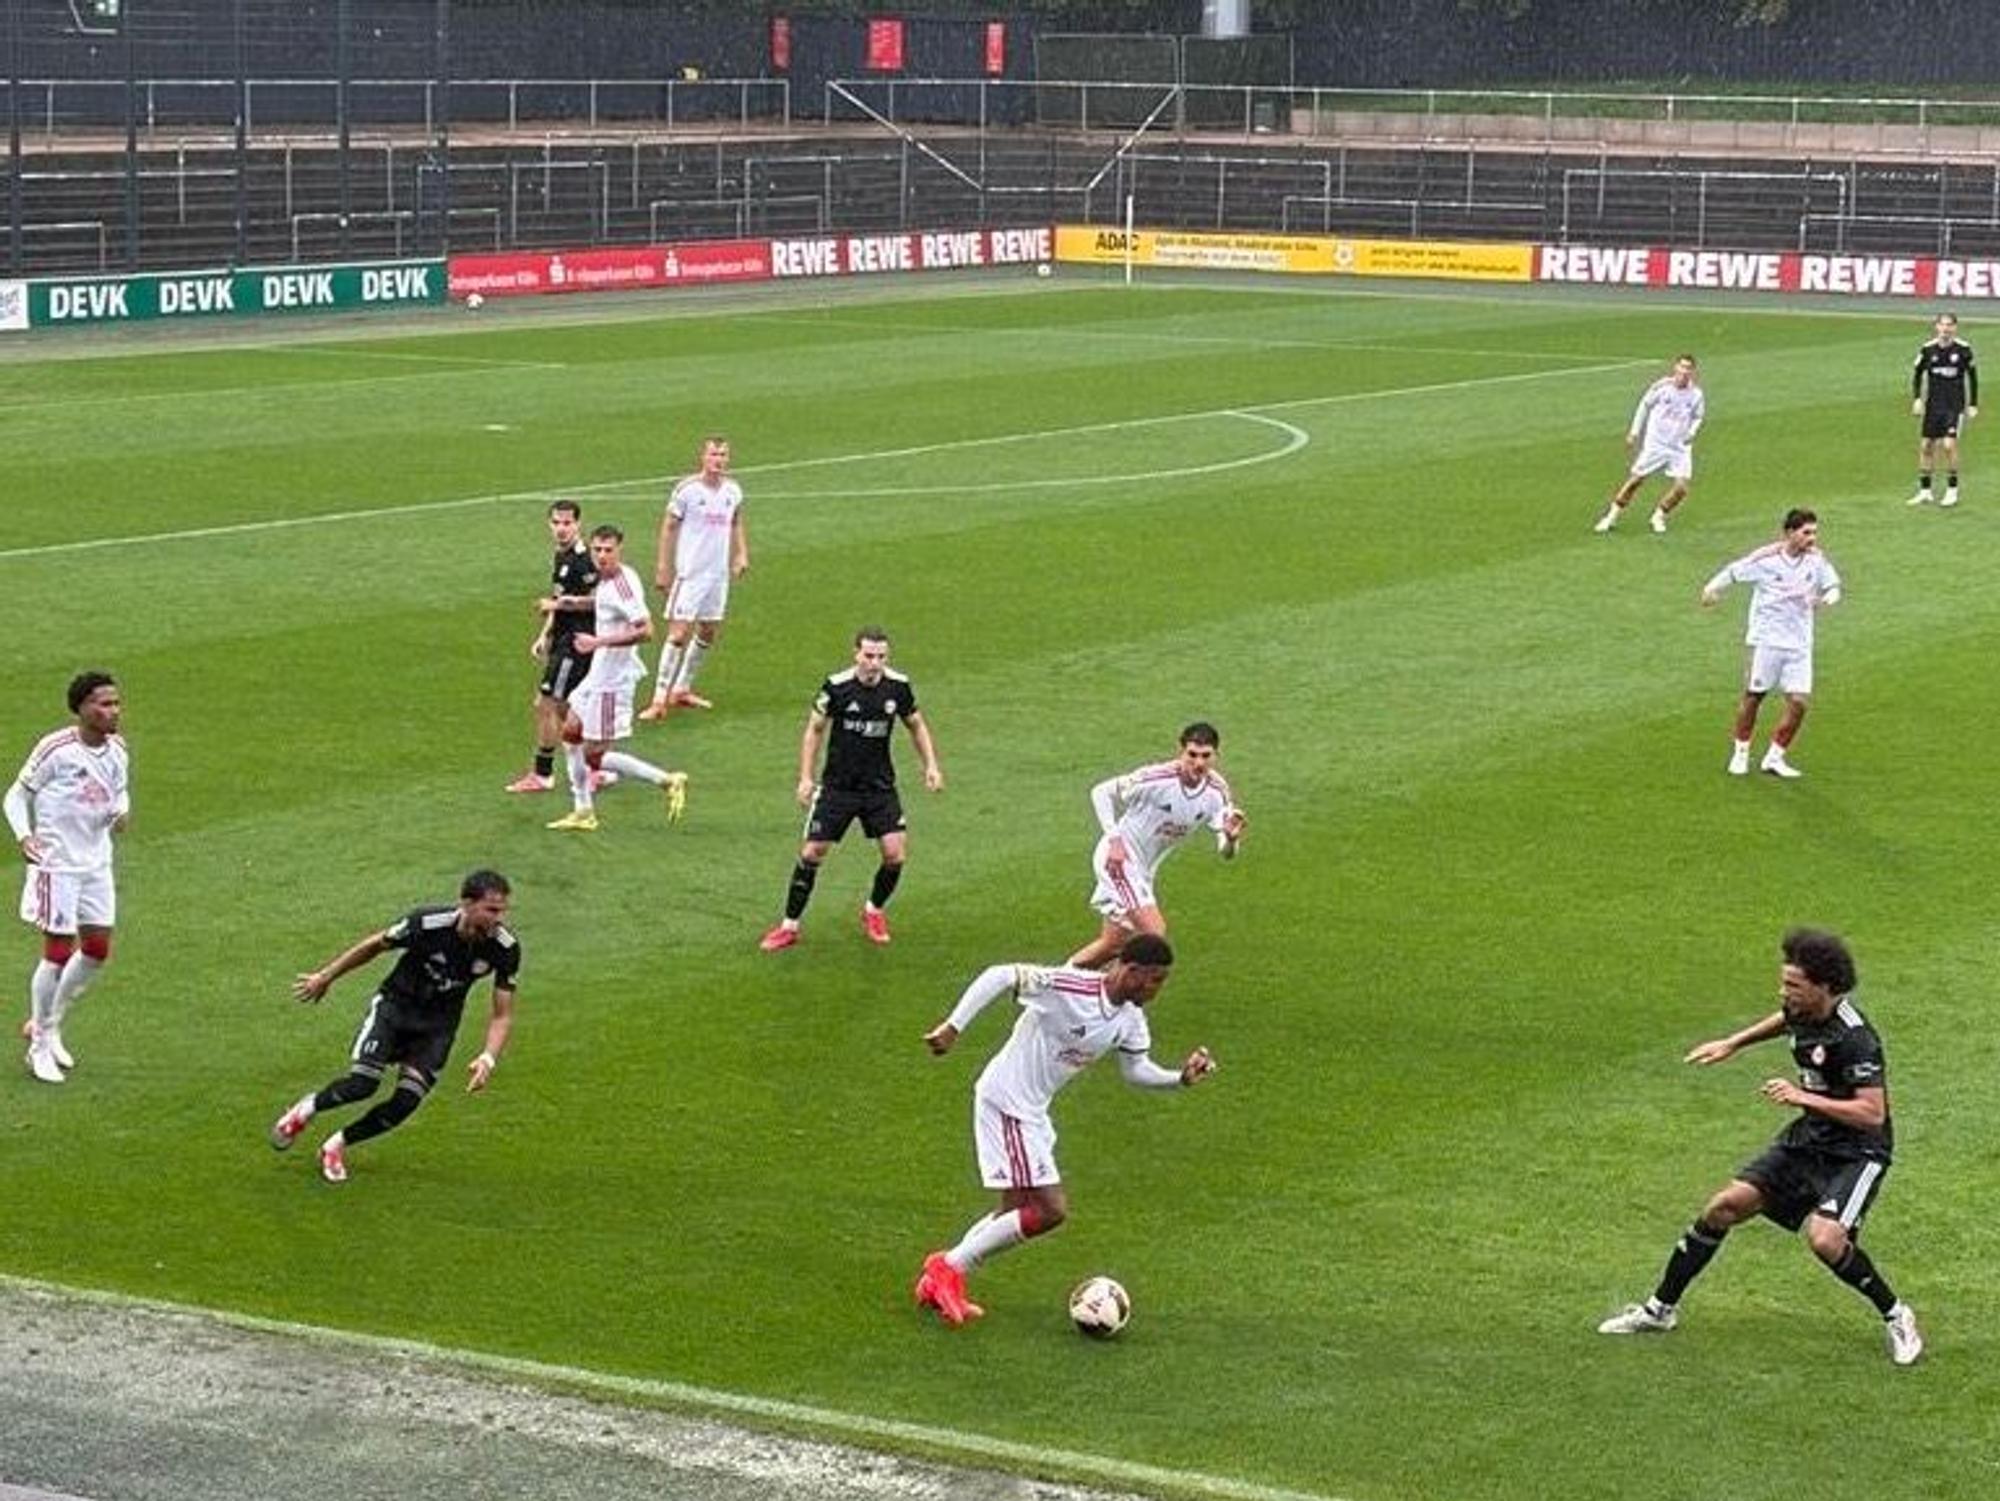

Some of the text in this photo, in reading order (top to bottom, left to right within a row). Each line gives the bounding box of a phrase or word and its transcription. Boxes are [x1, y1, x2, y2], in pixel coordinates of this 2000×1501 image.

[772, 240, 839, 276] REWE
[849, 236, 914, 271] REWE
[922, 232, 983, 268] REWE
[991, 228, 1050, 263] REWE
[1095, 232, 1139, 251] ADAC
[49, 283, 129, 319] DEVK
[160, 278, 235, 314] DEVK
[263, 272, 335, 307] DEVK
[362, 267, 429, 301] DEVK
[1541, 246, 2000, 297] REWE REWE REWE RE
